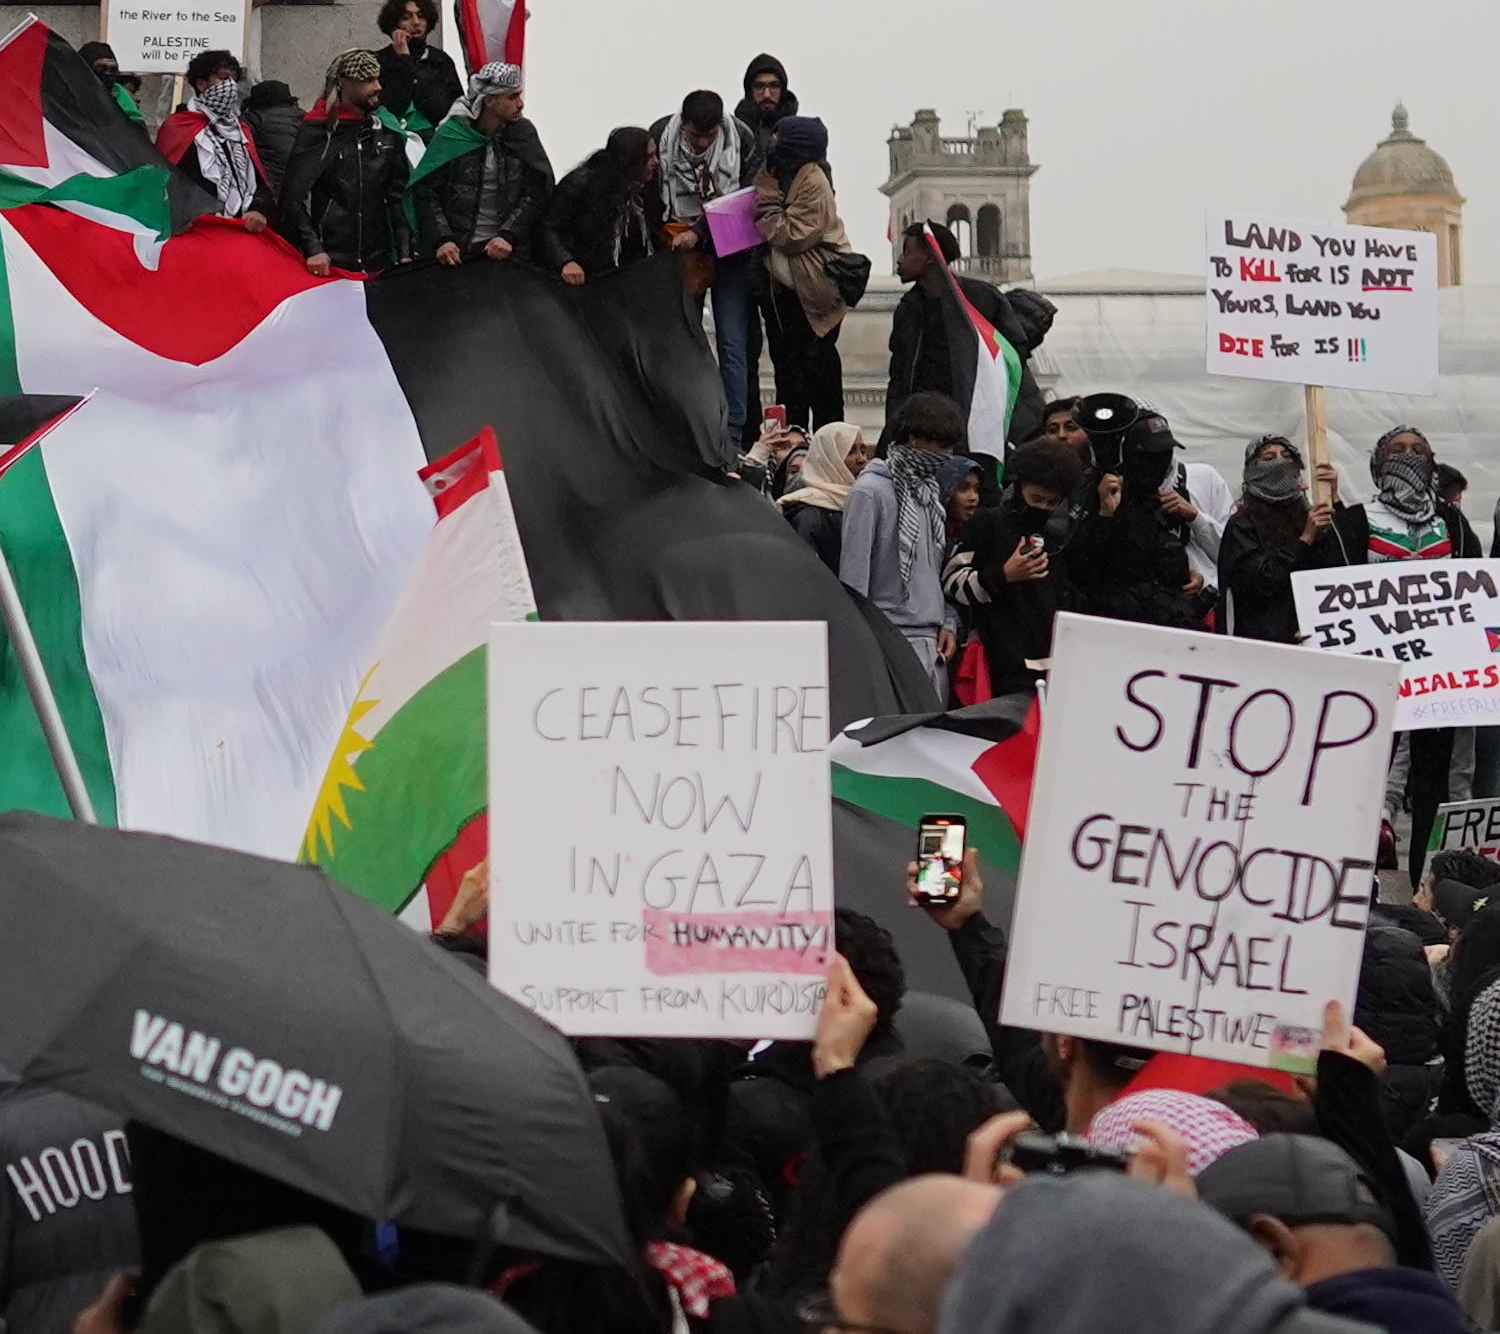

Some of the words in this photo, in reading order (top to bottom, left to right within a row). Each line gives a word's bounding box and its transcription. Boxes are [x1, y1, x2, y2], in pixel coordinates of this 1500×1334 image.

[120, 10, 138, 20] the
[142, 10, 172, 21] River
[176, 11, 188, 21] to
[192, 11, 210, 22] the
[214, 12, 236, 23] Sea
[141, 50, 160, 60] will
[165, 51, 178, 60] be
[143, 36, 209, 47] PALESTINE
[1224, 220, 1301, 253] LAND
[1311, 234, 1356, 258] YOU
[1364, 239, 1417, 262] HAVE
[1286, 263, 1322, 283] FOR
[1331, 265, 1349, 285] IS
[1362, 268, 1414, 289] NOT
[1211, 289, 1279, 318] YOURS,
[1286, 294, 1341, 317] LAND
[1347, 302, 1381, 320] YOU
[1219, 333, 1264, 358] DIE
[1271, 335, 1299, 357] FOR
[1314, 337, 1340, 355] IS
[1314, 619, 1357, 648] IS
[1369, 603, 1475, 635] WHITE
[531, 682, 828, 755] CEASEFIRE
[1116, 668, 1379, 807] STOP
[609, 764, 763, 835] NOW
[1173, 781, 1259, 822] THE
[567, 845, 622, 898] IN
[641, 848, 816, 920] GAZA
[1070, 812, 1376, 932] GENOCIDE
[513, 918, 598, 947] UNITE
[610, 921, 666, 943] FOR
[671, 917, 832, 965] HUMANITY!
[1116, 899, 1310, 996] ISRAEL
[520, 983, 627, 1016] SUPPORT
[640, 984, 708, 1014] FROM
[720, 977, 830, 1021] KURDISTA
[1033, 982, 1101, 1020] FREE
[1117, 992, 1277, 1051] PALESTINE
[129, 1008, 221, 1084] VAN
[216, 1046, 344, 1133] GOGH
